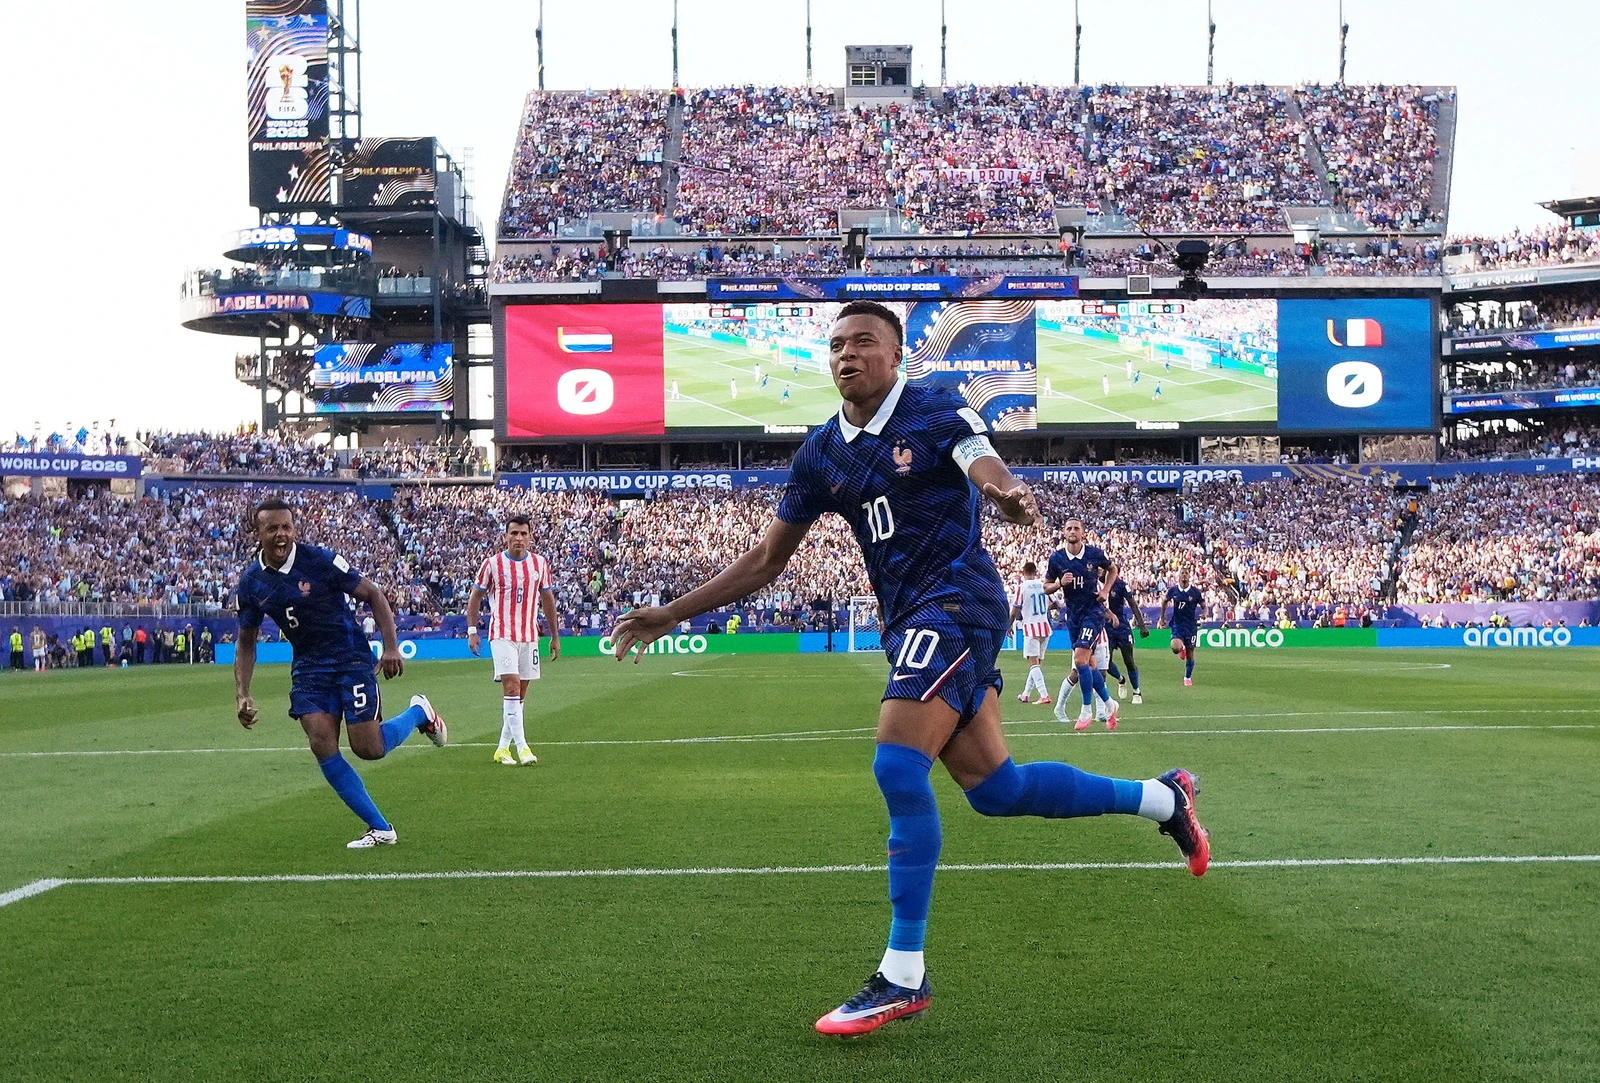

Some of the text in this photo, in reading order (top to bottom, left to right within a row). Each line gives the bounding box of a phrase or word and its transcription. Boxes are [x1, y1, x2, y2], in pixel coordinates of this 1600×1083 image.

[266, 127, 309, 138] 2026
[252, 142, 323, 152] PHILADELPHIA
[240, 228, 296, 244] 2026
[196, 294, 309, 314] PHILADELPHIA
[1455, 340, 1502, 350] PHILADELPHIA
[1570, 334, 1596, 342] WORLD
[922, 360, 1020, 372] PHILADELPHIA
[330, 370, 437, 384] PHILADELPHIA
[1456, 399, 1502, 408] PHILADELPHIA
[764, 424, 808, 433] Hisense
[1136, 420, 1180, 430] Hisense
[0, 457, 128, 472] WORLD CUP 2026
[1572, 458, 1600, 469] PH
[531, 474, 732, 490] FIFA WORLD CUP 2026
[1044, 471, 1079, 484] FIFA
[1146, 470, 1180, 484] CUP
[862, 495, 895, 543] 10
[1072, 576, 1084, 589] 14
[516, 587, 522, 604] 6
[1030, 593, 1046, 616] 10
[285, 606, 299, 628] 5
[1081, 628, 1093, 640] 14
[1196, 629, 1284, 647] ramco
[1463, 627, 1571, 646] aramco
[895, 628, 940, 670] 10
[532, 649, 538, 665] 6
[353, 683, 367, 708] 5
